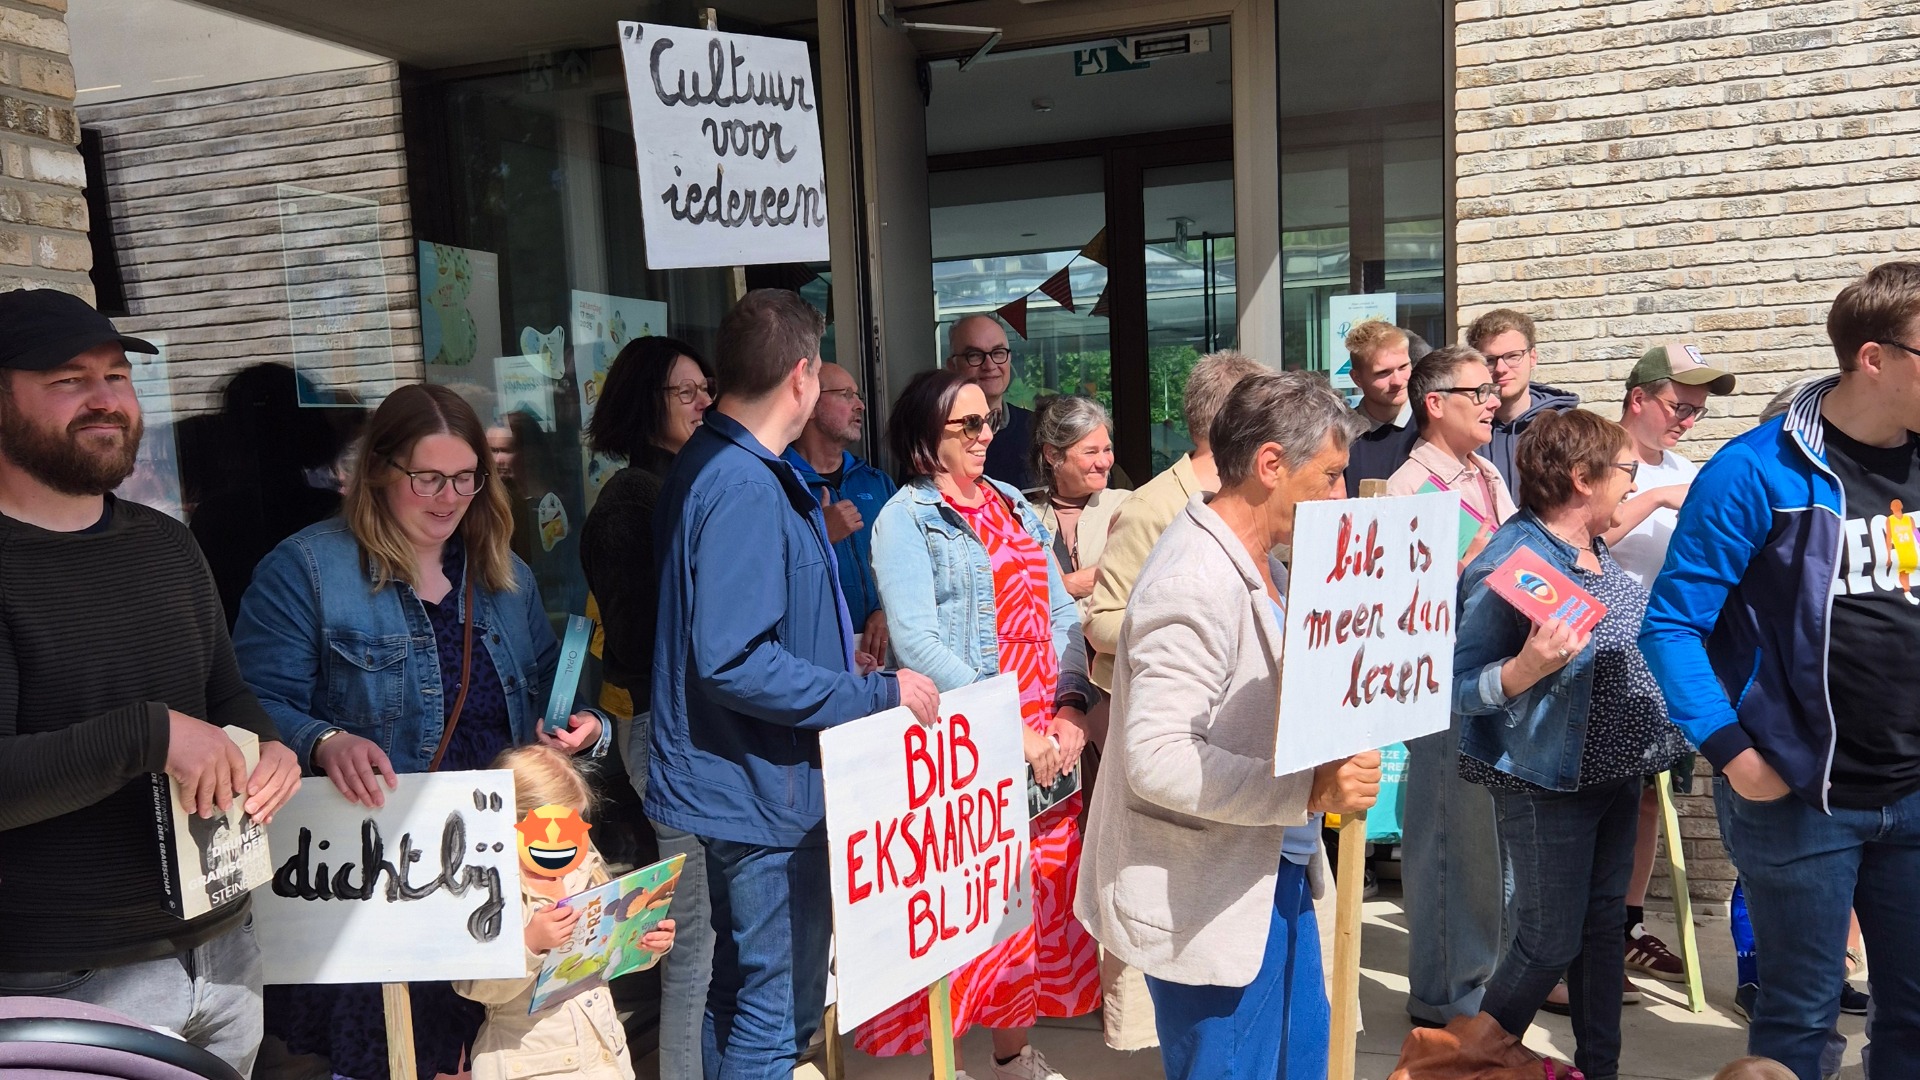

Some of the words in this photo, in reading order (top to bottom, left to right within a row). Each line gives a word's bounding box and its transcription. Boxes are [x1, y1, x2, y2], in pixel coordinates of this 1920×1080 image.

[702, 118, 797, 163] voor
[1410, 516, 1432, 573] is
[1398, 579, 1450, 637] dan
[1342, 643, 1439, 707] lezen
[152, 785, 163, 822] DRUIVEN
[157, 823, 166, 841] DER
[212, 823, 265, 857] DRUIVEN
[847, 778, 1015, 904] EKSAARDE
[159, 842, 172, 895] GRAMSCHAP
[212, 870, 270, 904] STEINBECK
[585, 895, 602, 947] T-REX
